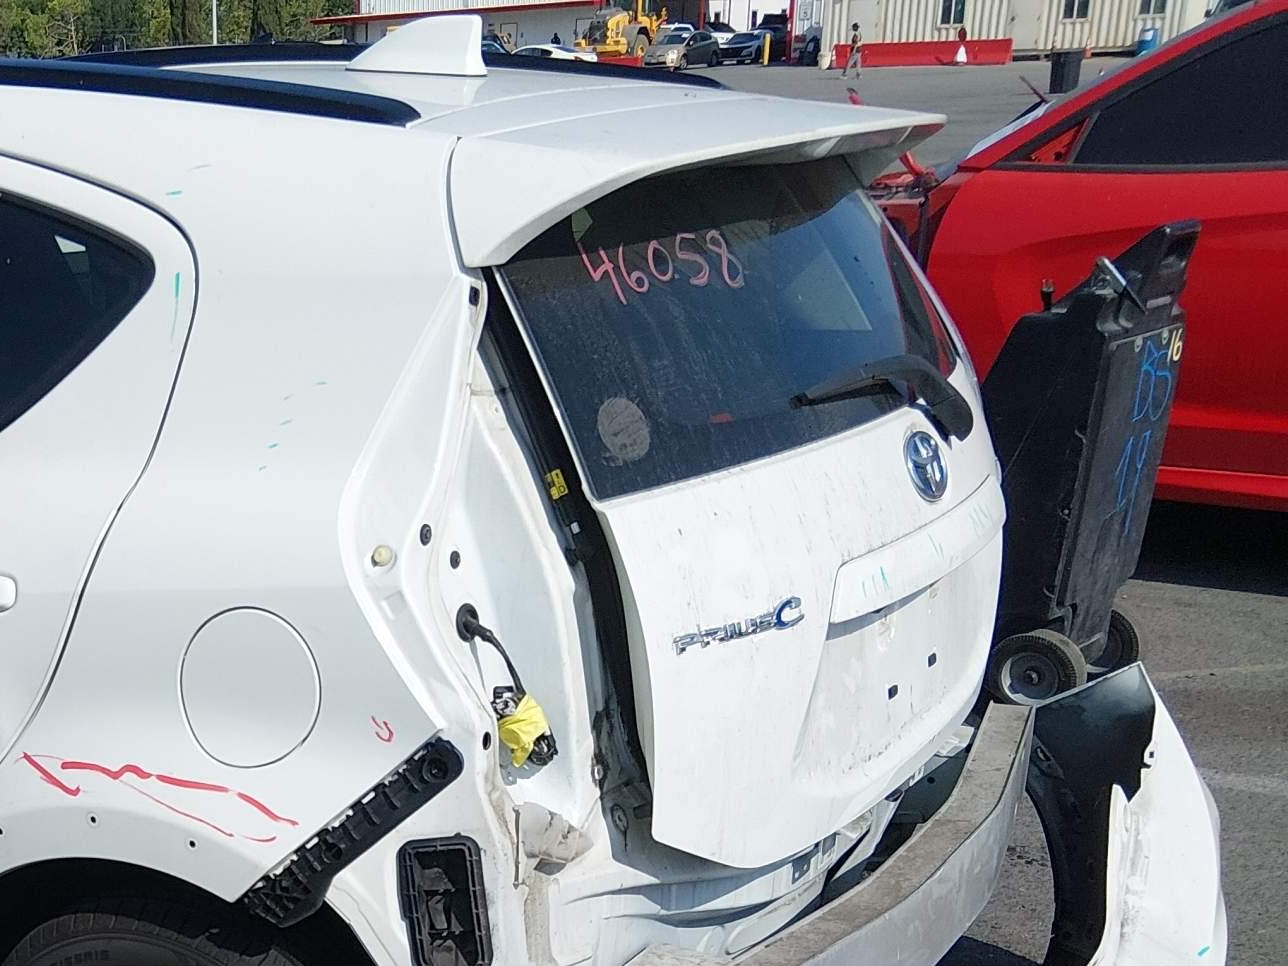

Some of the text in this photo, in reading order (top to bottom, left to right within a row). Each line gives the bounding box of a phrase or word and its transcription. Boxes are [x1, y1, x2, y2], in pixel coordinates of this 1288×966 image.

[577, 229, 744, 305] 46058
[1165, 328, 1183, 365] 16
[672, 612, 776, 656] PRIUS
